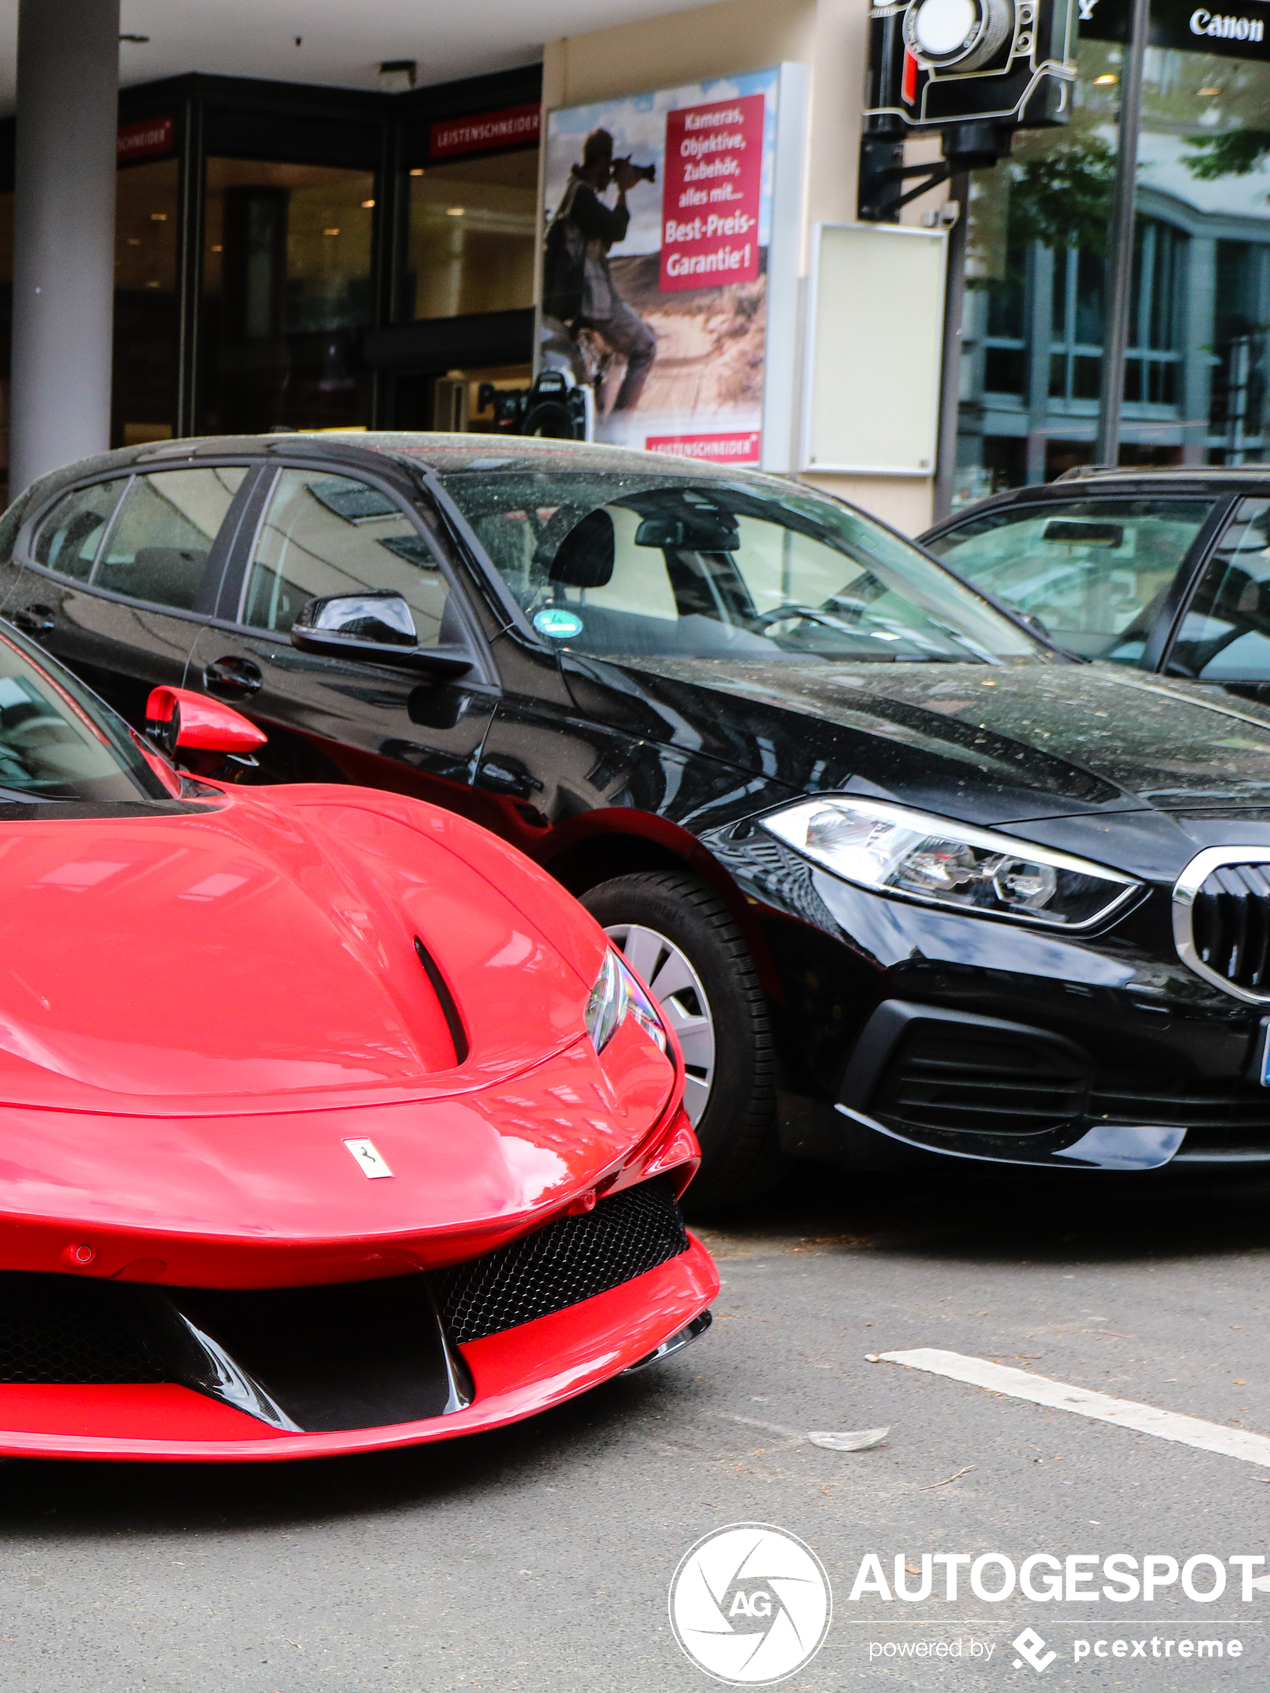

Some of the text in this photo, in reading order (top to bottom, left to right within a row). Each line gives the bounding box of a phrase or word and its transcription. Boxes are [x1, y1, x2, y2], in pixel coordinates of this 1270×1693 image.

[1189, 8, 1265, 42] Canon
[437, 113, 539, 148] LEISTENSCHNEIDER
[684, 107, 745, 132] Kameras,
[680, 131, 747, 160] Objektive,
[683, 156, 741, 182] Zubehör,
[678, 182, 744, 208] alles mit...
[665, 209, 756, 243] Best-Preis-
[651, 439, 751, 457] LEISTENSCHNEIDER
